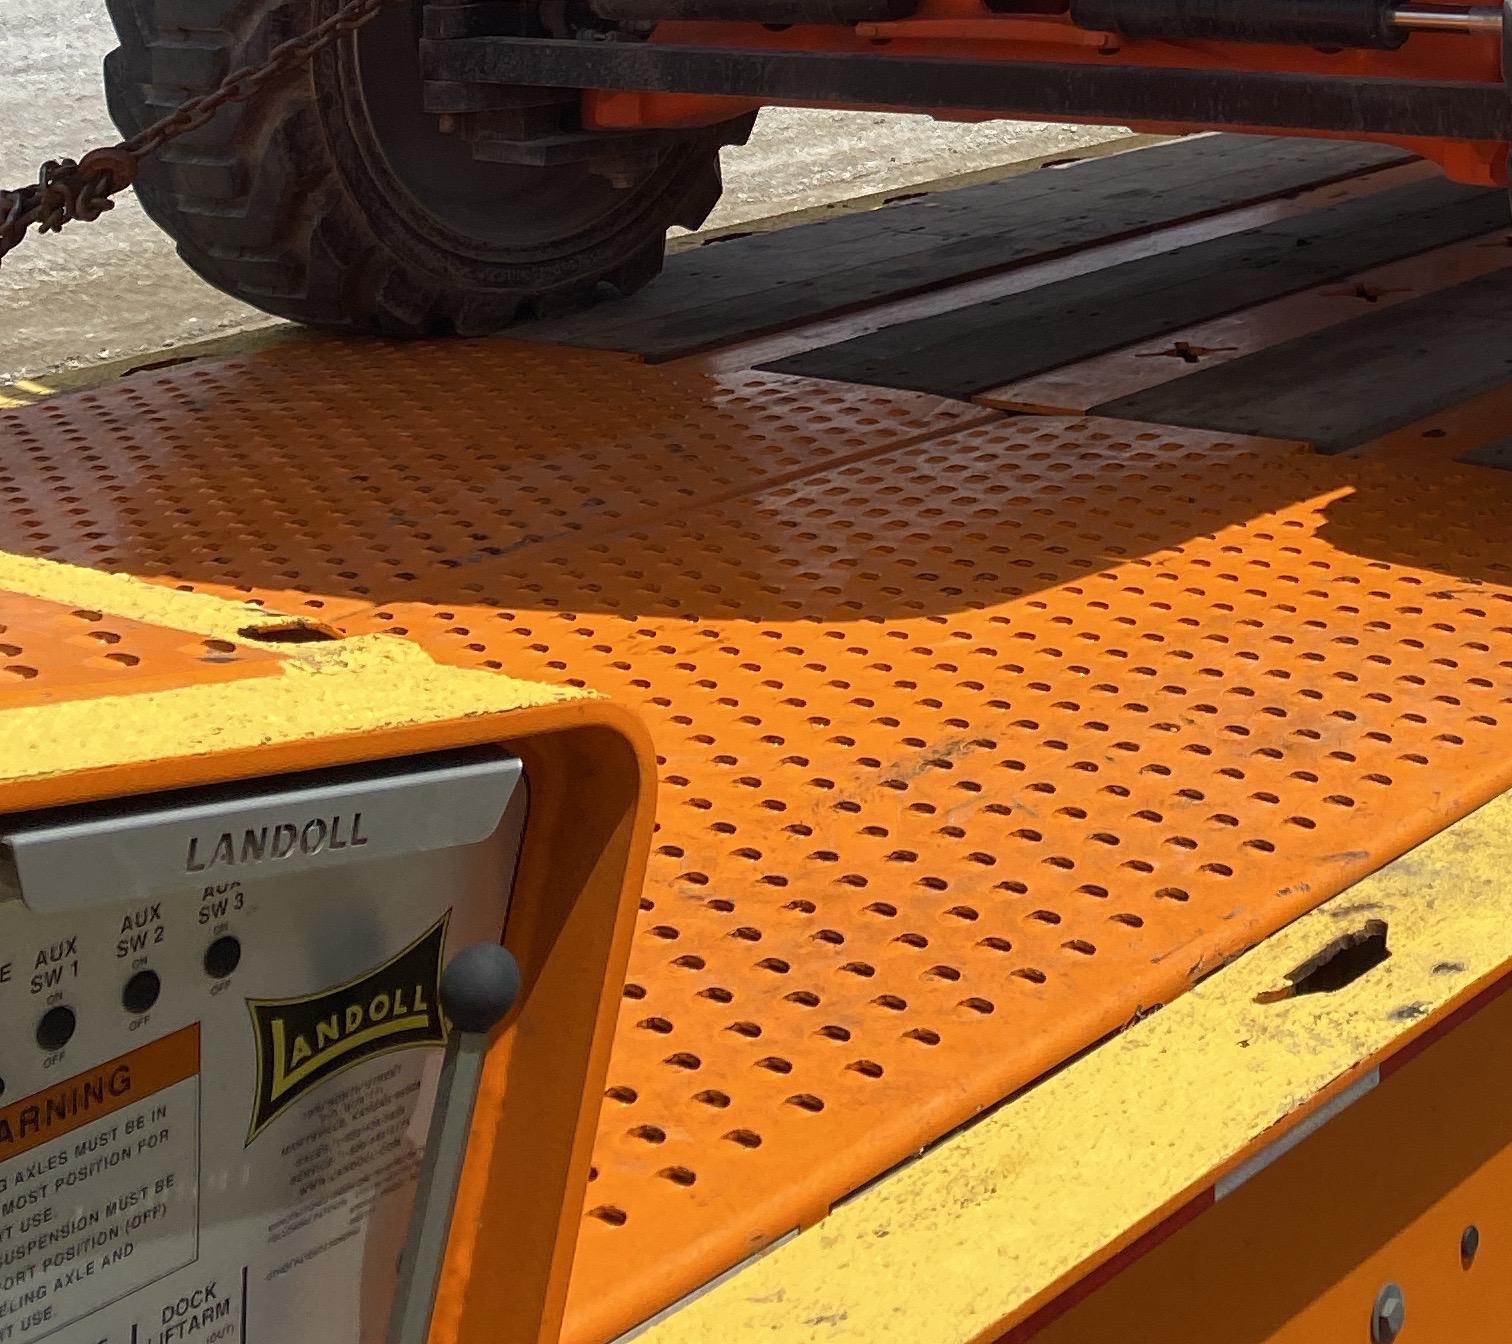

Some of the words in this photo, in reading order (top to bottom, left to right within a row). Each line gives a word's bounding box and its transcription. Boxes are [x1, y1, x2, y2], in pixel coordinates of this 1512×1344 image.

[184, 812, 369, 873] LANDOLL
[120, 902, 162, 934] AUX
[198, 896, 229, 925] SW
[234, 892, 245, 910] 3
[35, 935, 78, 969] AUX
[116, 930, 150, 958] SW
[153, 926, 165, 944] 2
[30, 963, 64, 995] SW
[71, 959, 79, 977] 1
[270, 984, 429, 1103] LANDOLL
[0, 1064, 132, 1144] ARNING
[14, 1151, 68, 1186] AXLES
[74, 1127, 118, 1159] MUST
[125, 1115, 145, 1135] BE
[152, 1104, 167, 1123] IN
[55, 1148, 132, 1192] POSITION
[138, 1128, 169, 1154] FOR
[0, 1210, 99, 1267] USPENSION
[106, 1187, 150, 1218] MUST
[154, 1173, 176, 1195] BE
[43, 1225, 120, 1273] POSITION
[53, 1260, 95, 1293] AXLE
[101, 1242, 135, 1270] AND
[161, 1280, 217, 1326] DOCK
